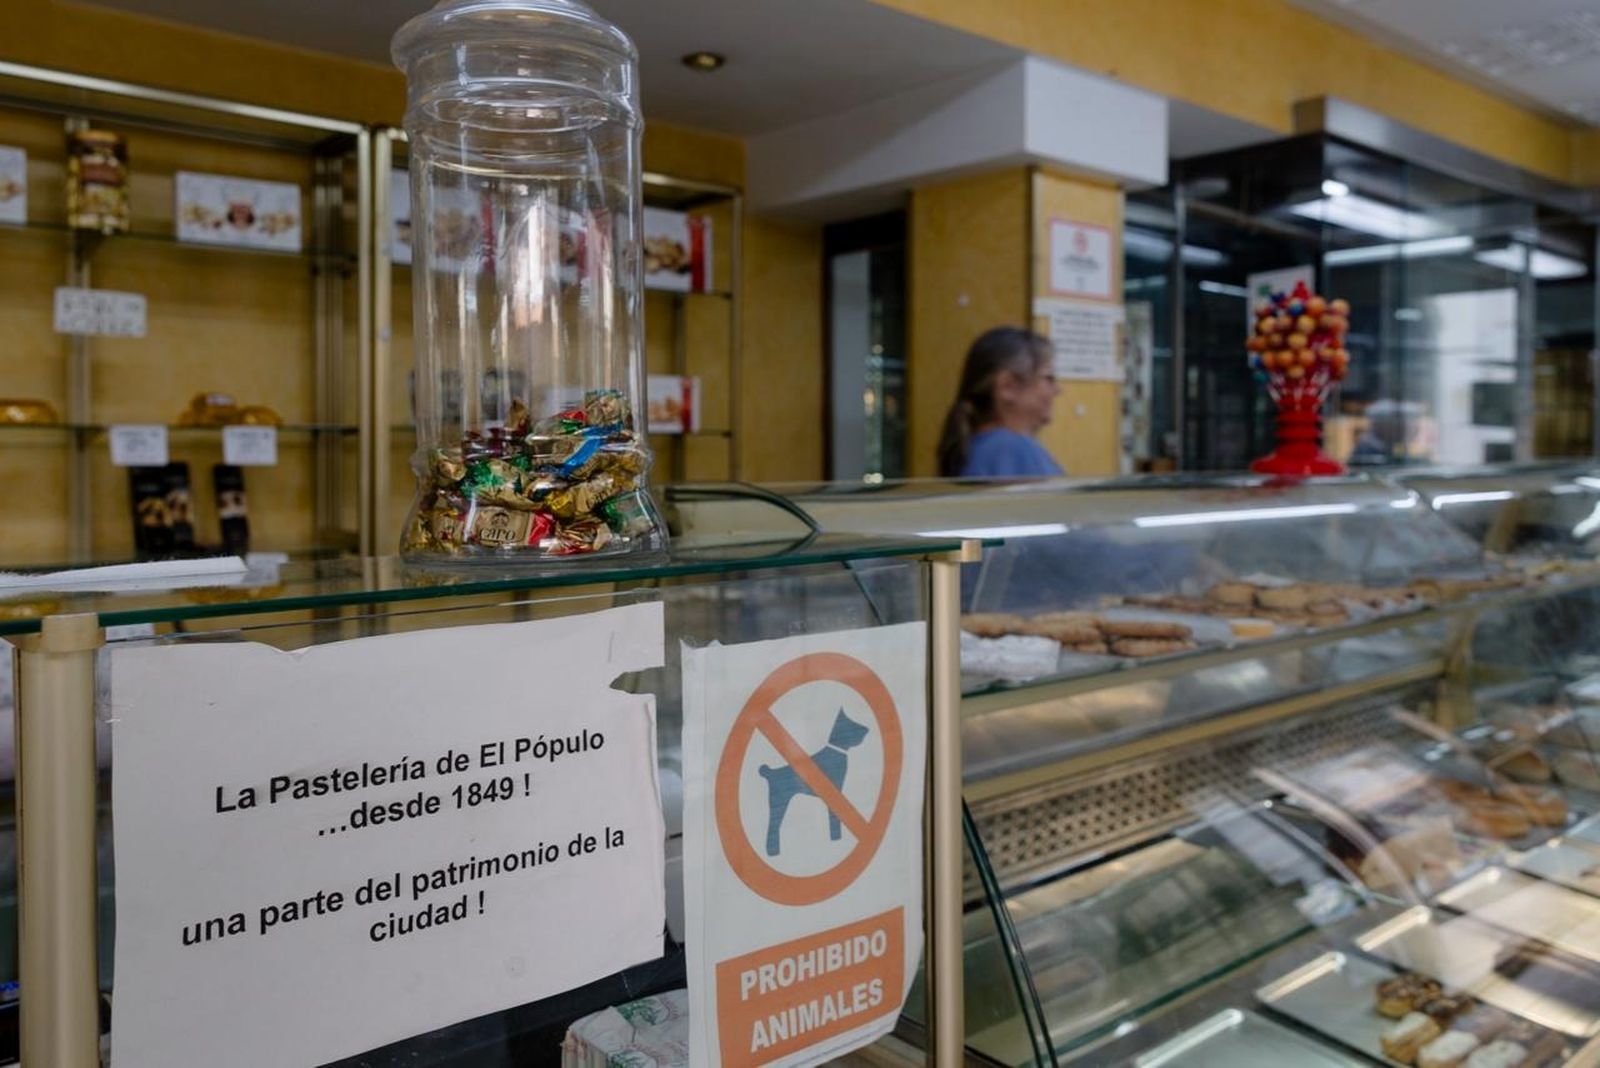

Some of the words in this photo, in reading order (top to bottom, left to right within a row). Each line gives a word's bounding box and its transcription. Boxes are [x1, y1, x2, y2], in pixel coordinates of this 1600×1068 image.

[215, 785, 257, 814] La
[269, 754, 426, 805] Pastelería
[436, 749, 470, 776] de
[480, 741, 505, 769] El
[514, 729, 605, 763] Pópulo
[451, 776, 514, 810] 1849
[182, 912, 247, 947] una
[259, 890, 345, 936] parte
[354, 872, 401, 906] del
[412, 844, 560, 901] patrimonio
[567, 832, 597, 858] de
[605, 826, 625, 849] la
[369, 894, 468, 943] ciudad
[740, 929, 888, 1002] PROHIBIDO
[751, 978, 884, 1054] ANIMALES
